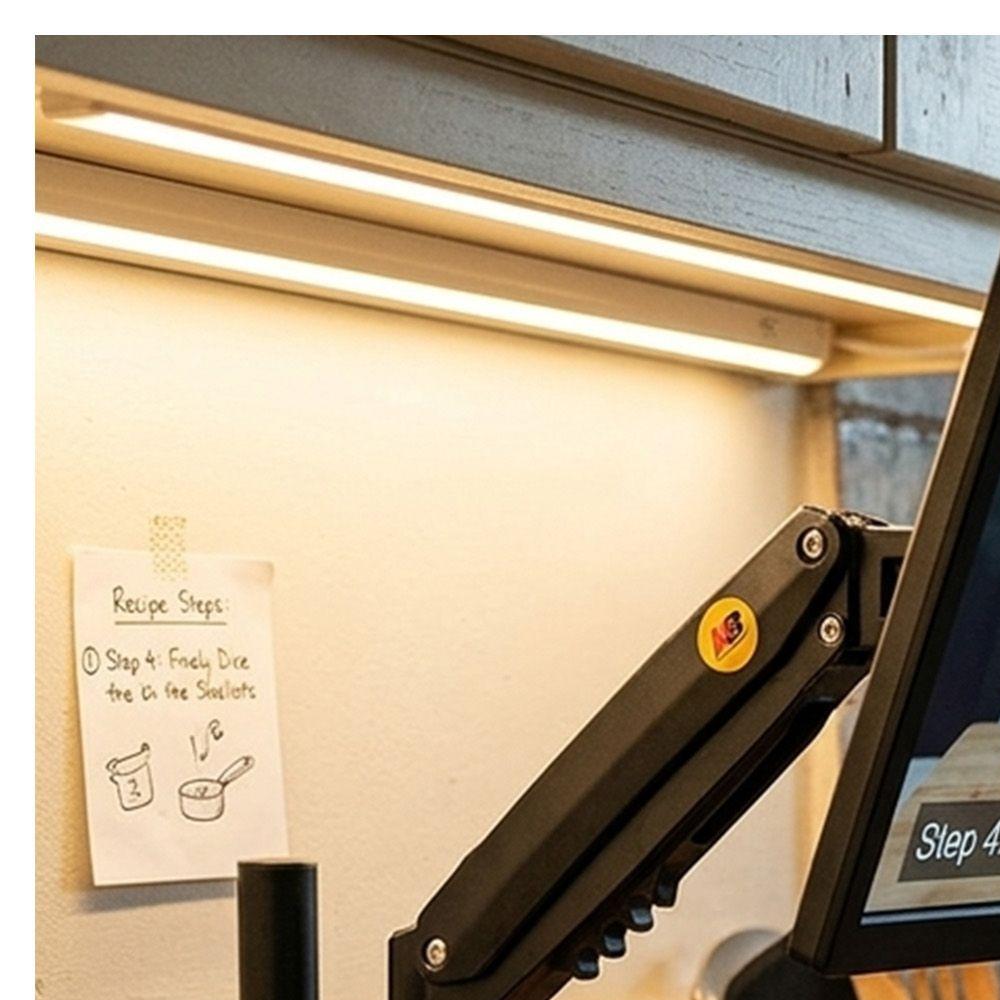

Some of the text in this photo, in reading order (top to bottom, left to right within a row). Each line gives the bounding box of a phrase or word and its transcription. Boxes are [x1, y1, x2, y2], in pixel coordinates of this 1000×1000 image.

[112, 585, 230, 621] Recipe Steps:
[915, 821, 978, 866] Step
